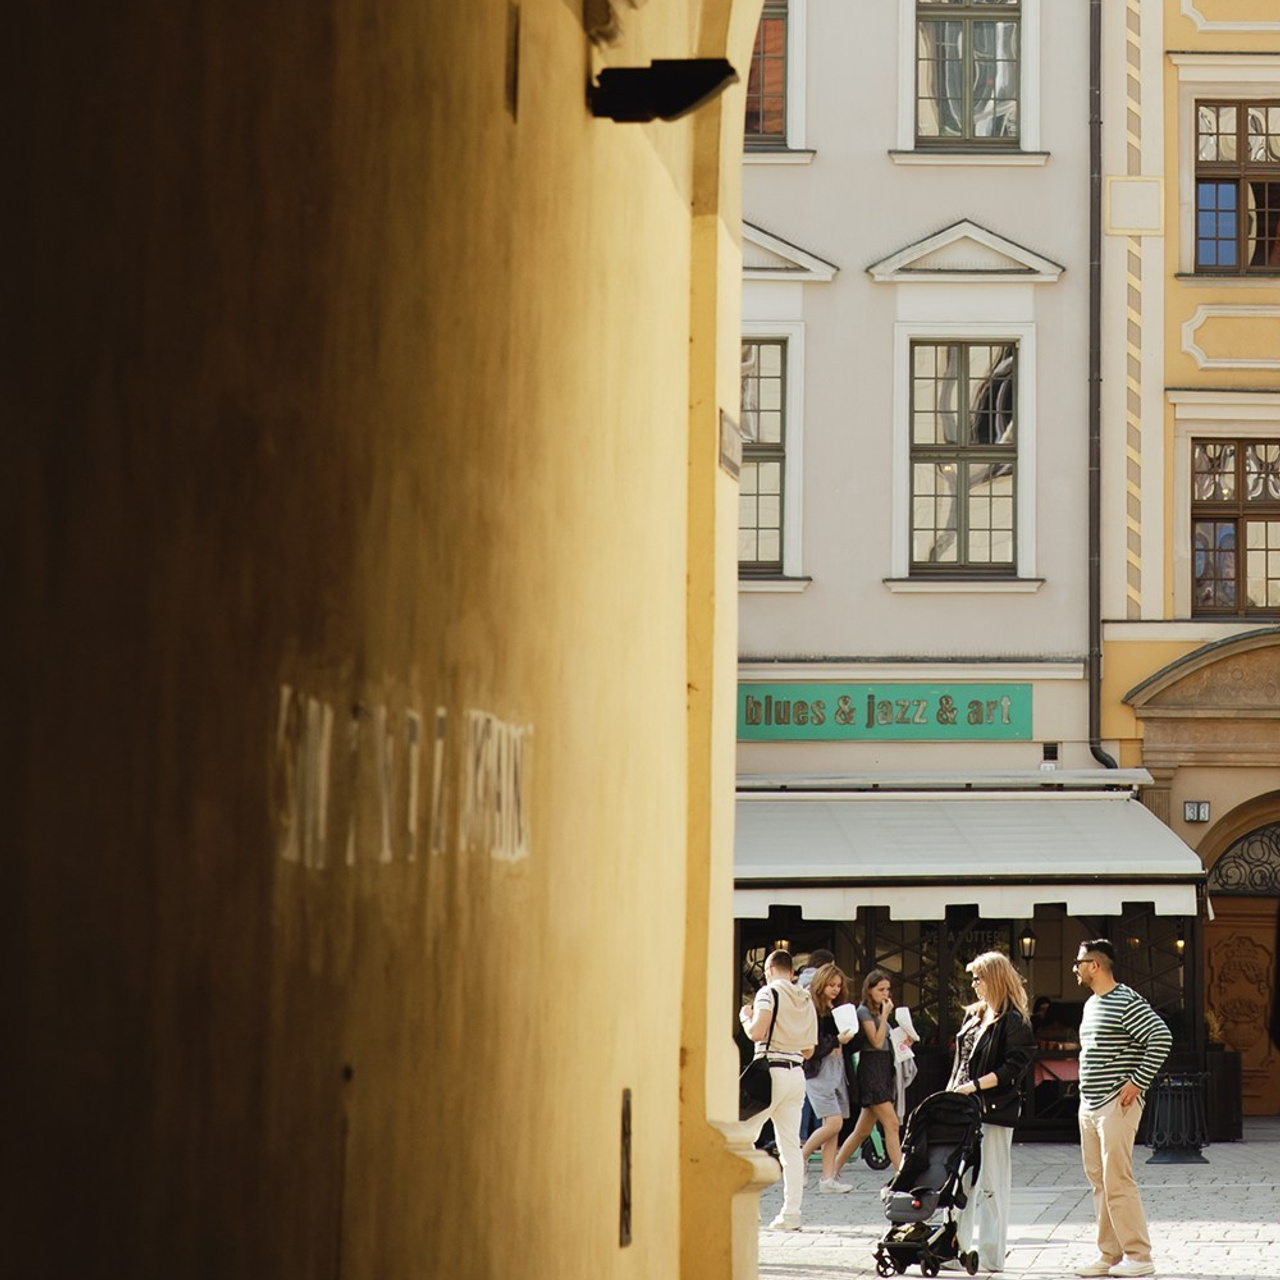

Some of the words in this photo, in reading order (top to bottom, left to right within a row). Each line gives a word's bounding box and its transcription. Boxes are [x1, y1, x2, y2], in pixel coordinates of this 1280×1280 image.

[745, 695, 826, 726] blues
[834, 695, 856, 726] &
[865, 694, 928, 729] jazz
[936, 695, 957, 726] &
[967, 695, 1012, 726] art
